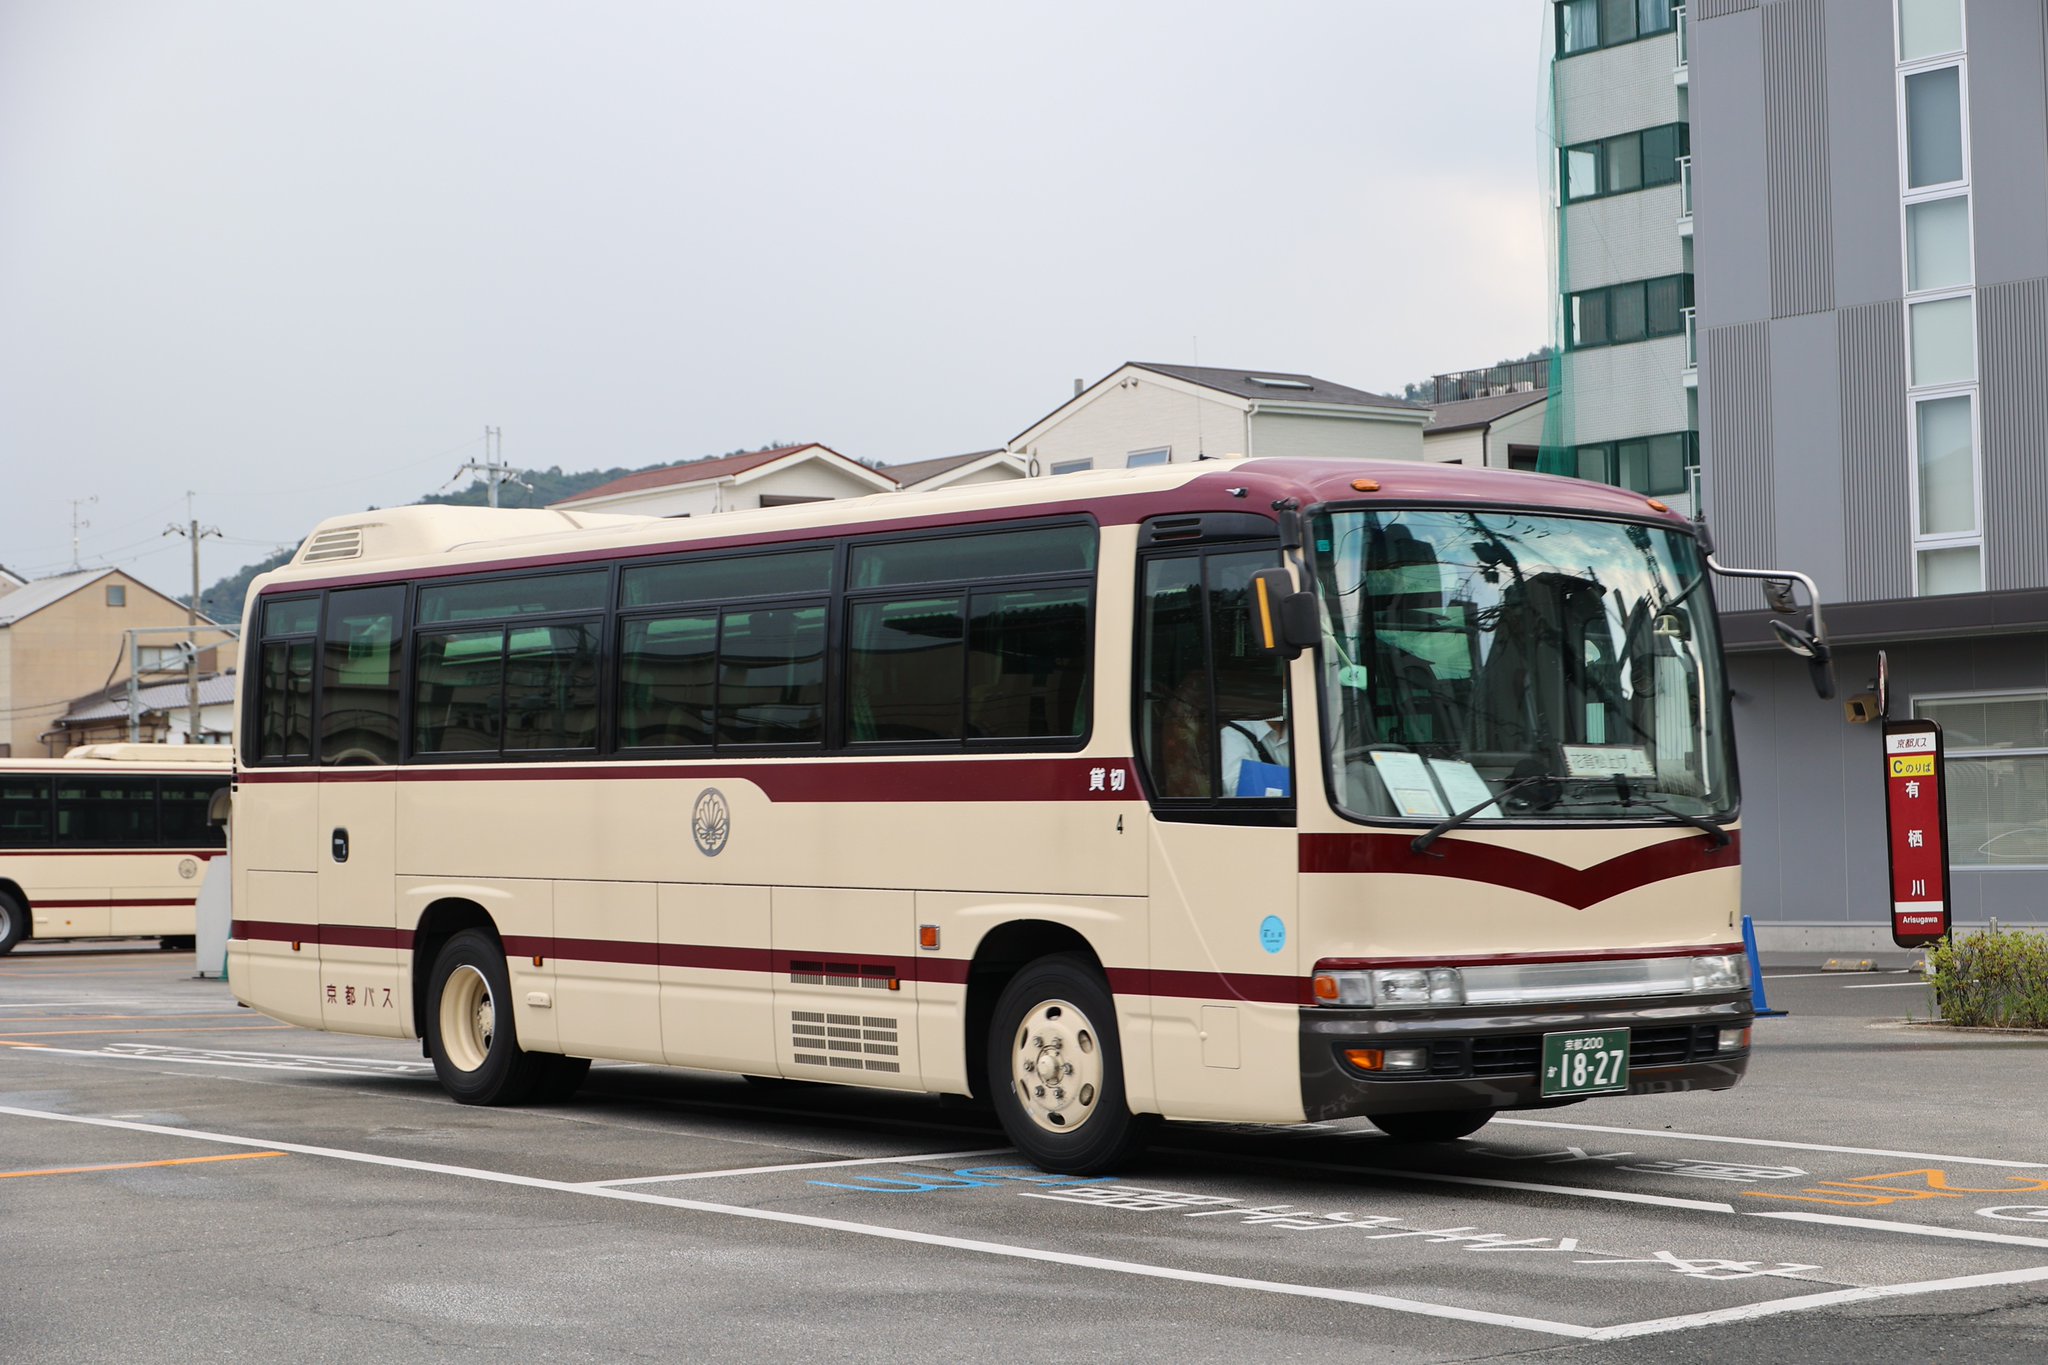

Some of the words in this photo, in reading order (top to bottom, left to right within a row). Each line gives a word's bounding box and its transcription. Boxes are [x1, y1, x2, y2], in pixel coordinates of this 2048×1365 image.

[1897, 737, 1927, 748] 京都バス
[1089, 767, 1125, 791] 貸切
[1116, 814, 1123, 834] 4
[1906, 780, 1926, 897] 有栖川
[1902, 915, 1938, 925] Arisugawa
[326, 984, 394, 1008] 京都バス
[1561, 1050, 1624, 1087] 18-27
